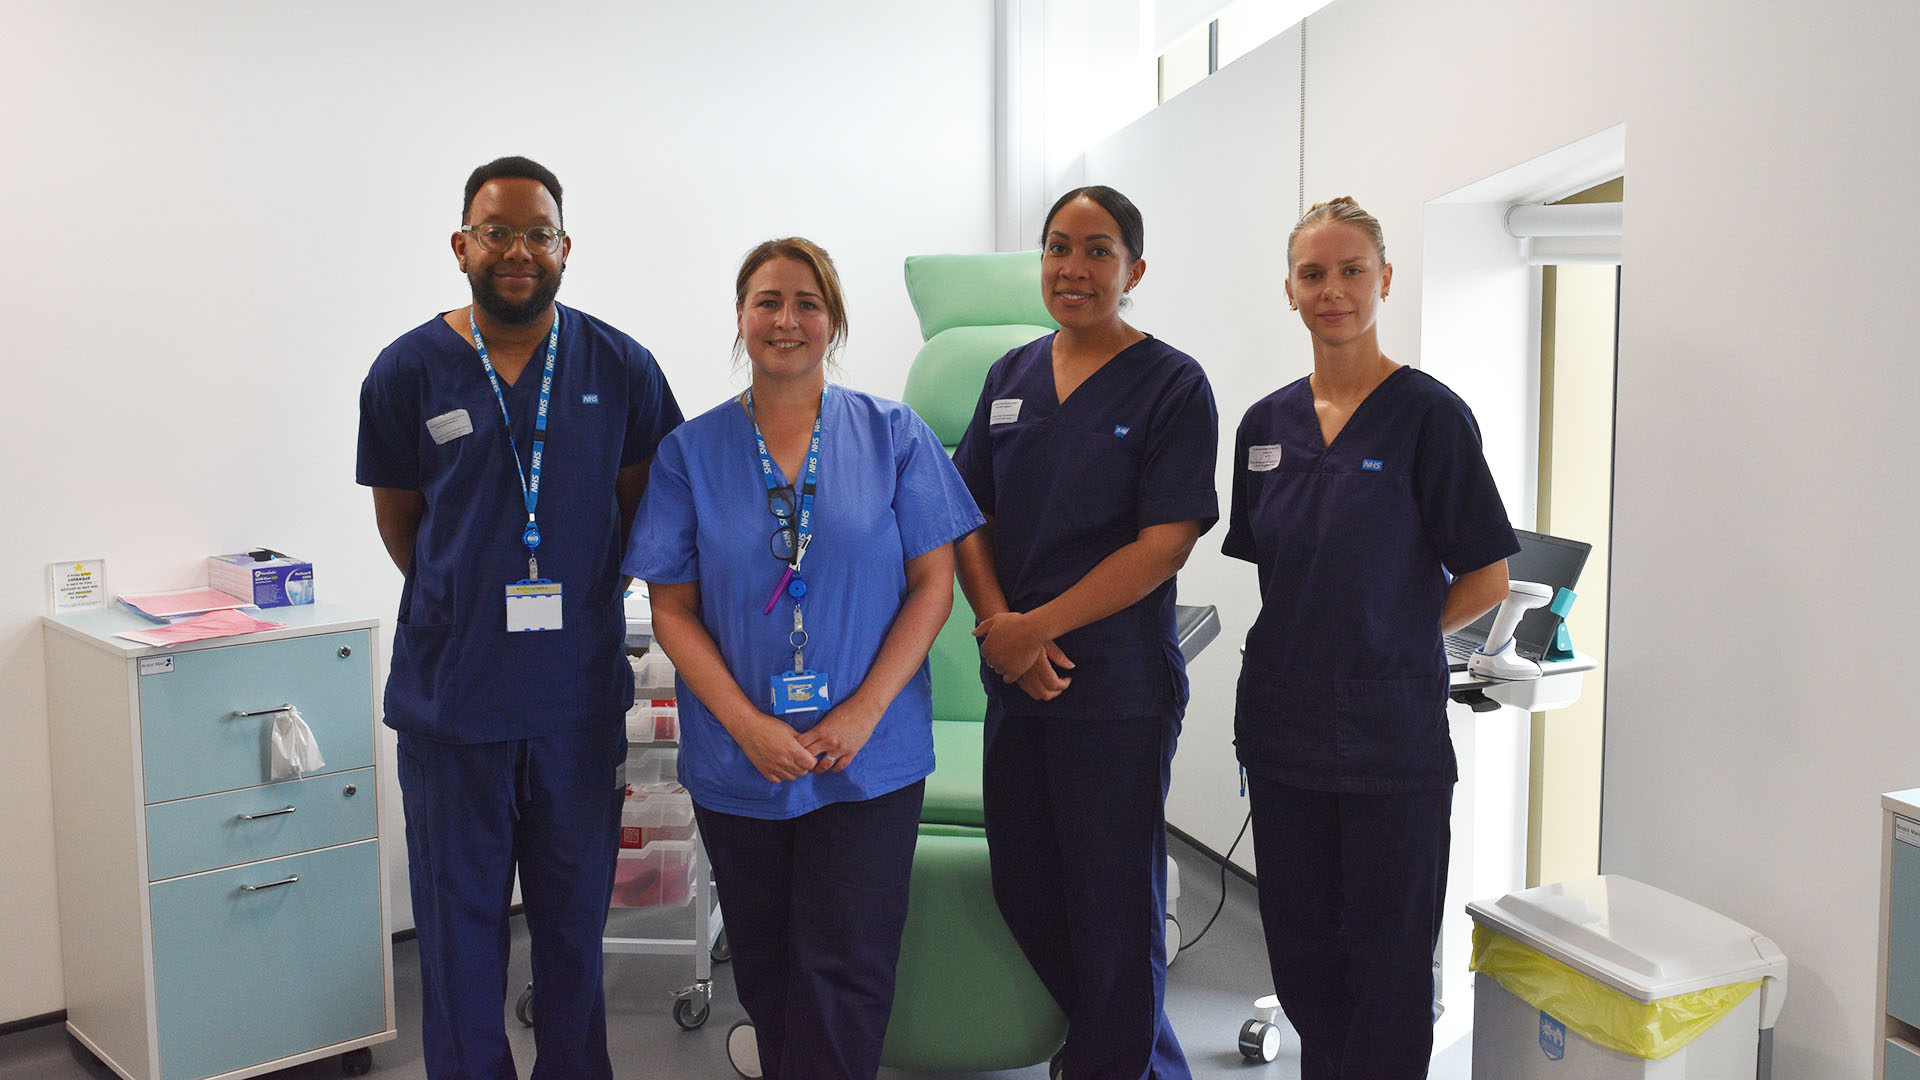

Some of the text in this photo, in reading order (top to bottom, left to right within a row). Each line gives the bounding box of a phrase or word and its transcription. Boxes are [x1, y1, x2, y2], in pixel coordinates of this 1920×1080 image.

[474, 333, 485, 350] NHS
[549, 332, 558, 350] NHS
[481, 354, 492, 372] NHS
[545, 353, 555, 371] NHS
[489, 375, 500, 393] NHS
[541, 375, 551, 394] NHS
[538, 398, 548, 416] NHS
[583, 395, 598, 403] NHS
[758, 439, 768, 455] NHS
[811, 437, 820, 453] NHS
[533, 450, 542, 470] NHS
[762, 459, 772, 475] NHS
[809, 457, 818, 474] NHS
[1364, 461, 1381, 469] NHS
[530, 474, 539, 493] NHS
[776, 509, 788, 526] NS
[801, 510, 810, 528] NHS
